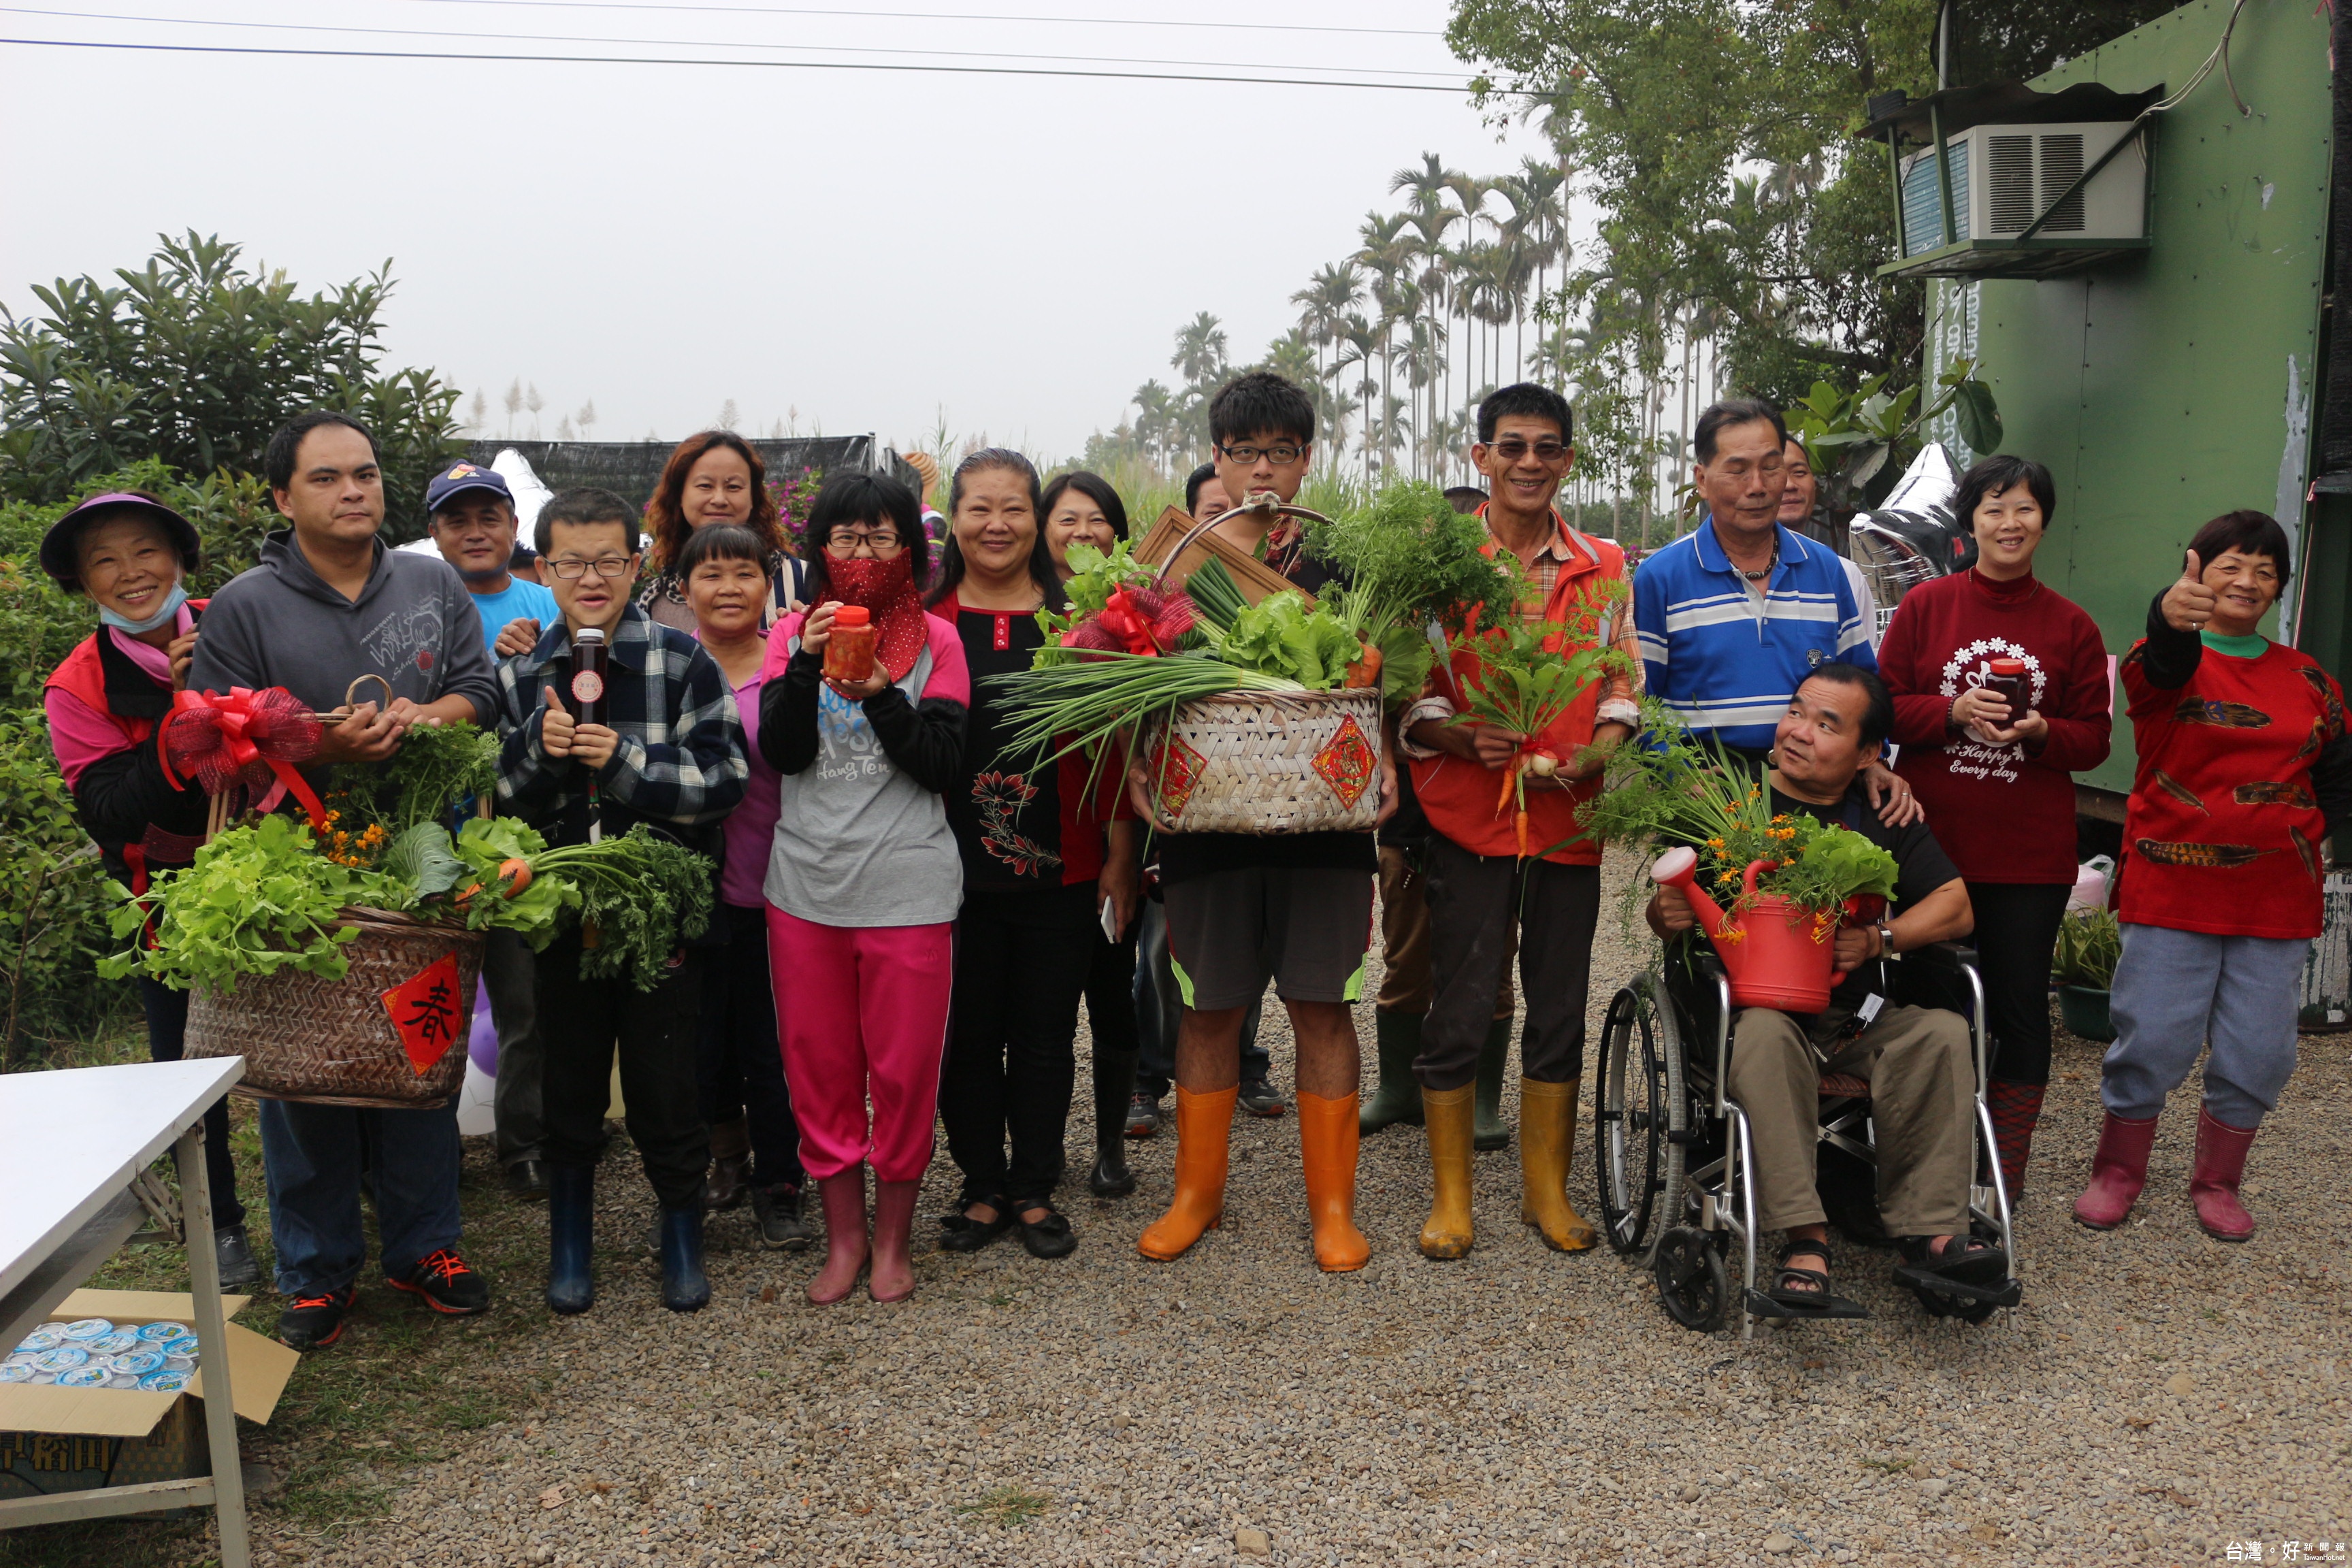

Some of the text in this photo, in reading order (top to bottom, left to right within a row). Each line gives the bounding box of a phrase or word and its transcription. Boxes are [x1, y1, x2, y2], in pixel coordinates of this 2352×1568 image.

[1959, 745, 2012, 766] Happy
[816, 755, 892, 781] Hang Ten
[1950, 760, 2019, 783] Every day
[402, 977, 454, 1046] 春
